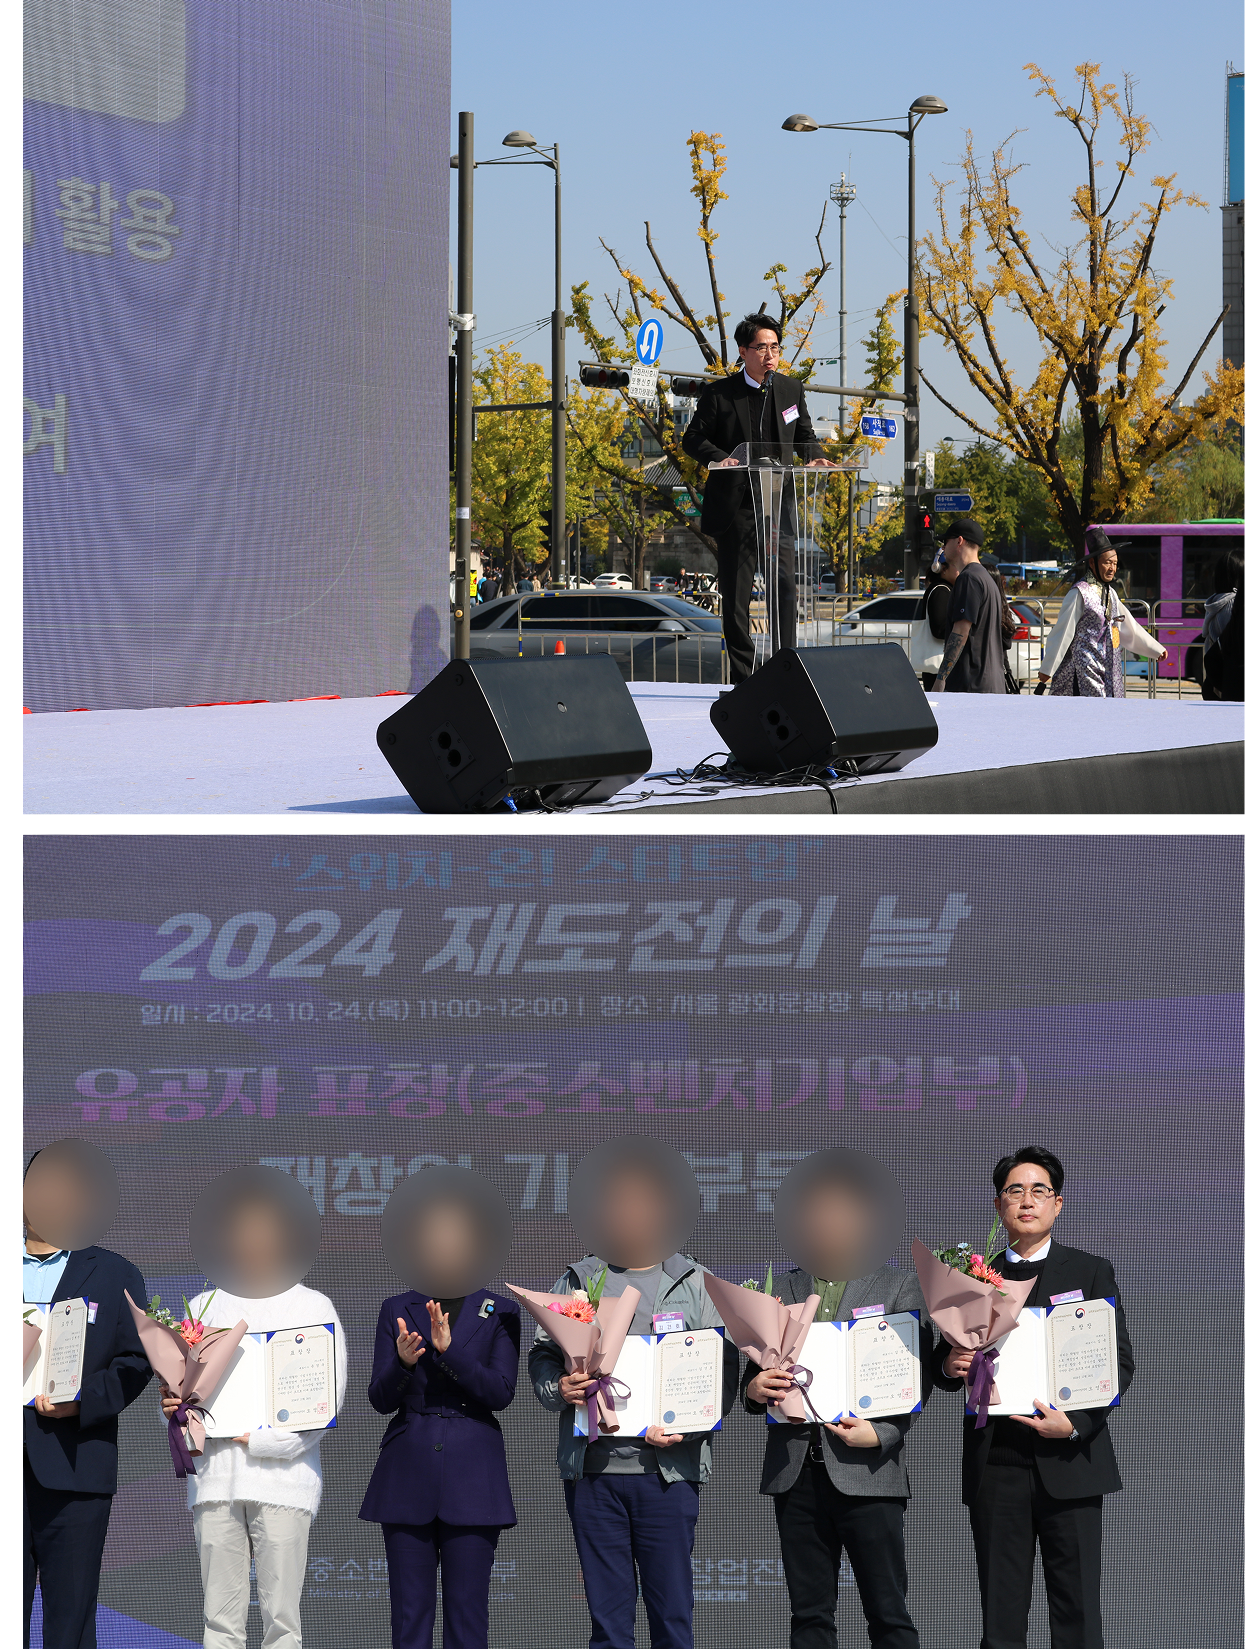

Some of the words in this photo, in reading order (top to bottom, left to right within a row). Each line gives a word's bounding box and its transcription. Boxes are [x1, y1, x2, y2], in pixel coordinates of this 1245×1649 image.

[139, 909, 404, 981] 2024
[423, 895, 839, 976] 재도전의
[859, 893, 972, 968] 날
[141, 1003, 186, 1025] 일시
[600, 995, 649, 1016] 장소
[670, 994, 719, 1016] 서울
[72, 1066, 285, 1122] 유공자
